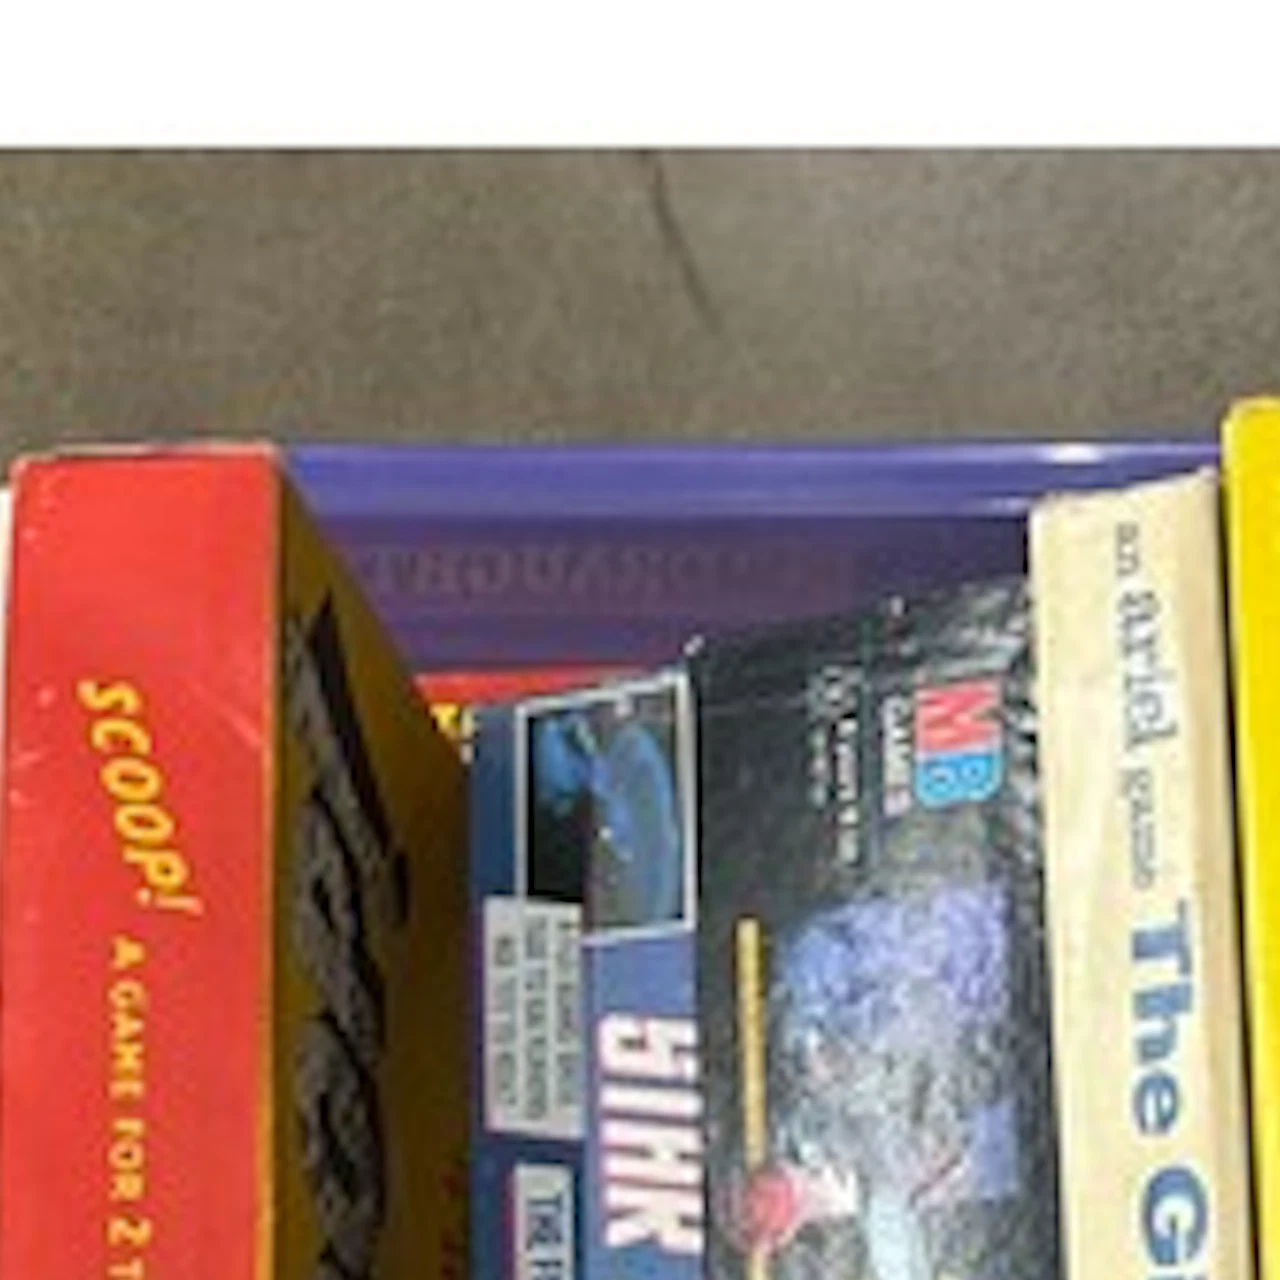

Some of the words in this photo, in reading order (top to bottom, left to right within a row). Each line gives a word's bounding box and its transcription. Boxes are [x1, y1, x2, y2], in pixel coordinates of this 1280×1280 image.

[914, 677, 1005, 808] MB
[76, 680, 205, 916] SCOOP!
[111, 936, 145, 970] A
[109, 980, 145, 1100] GAME
[1130, 900, 1195, 1136] The
[109, 1118, 144, 1200] FOR
[107, 1218, 152, 1248] 2
[528, 1186, 568, 1250] THE
